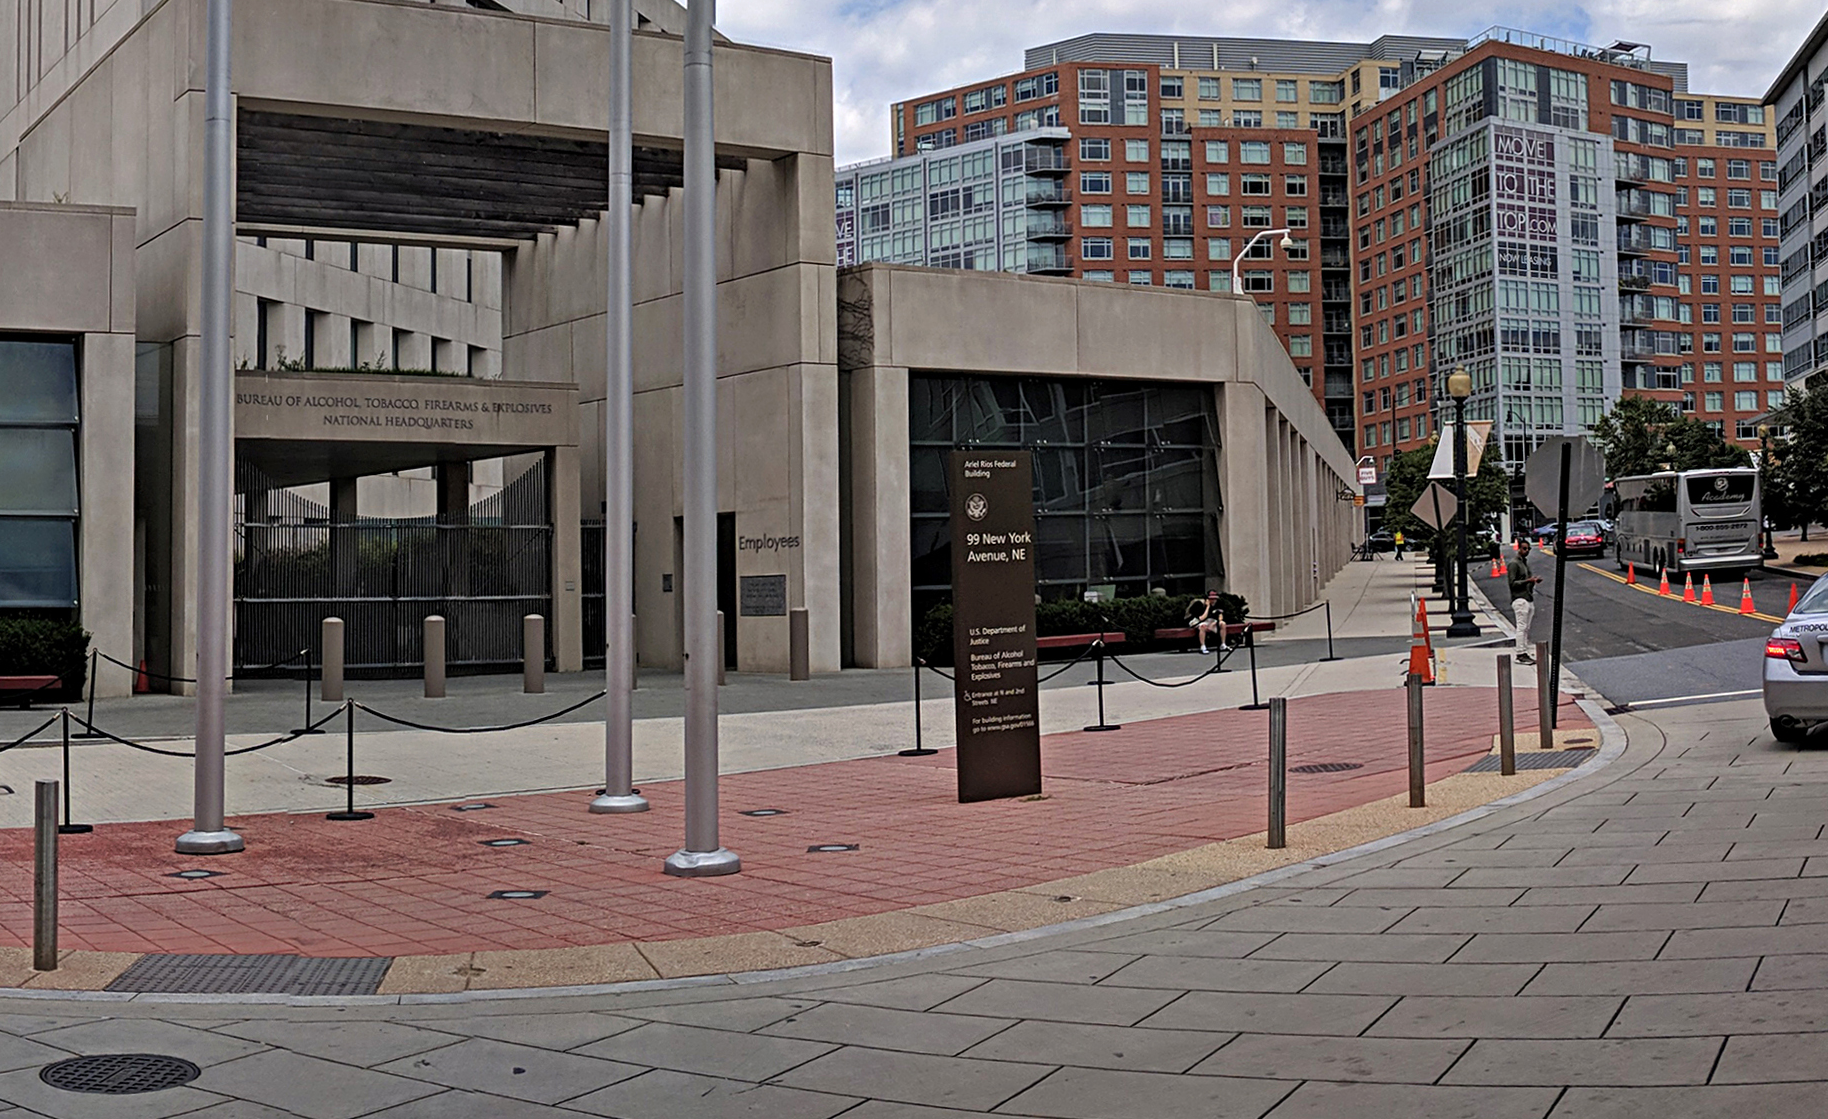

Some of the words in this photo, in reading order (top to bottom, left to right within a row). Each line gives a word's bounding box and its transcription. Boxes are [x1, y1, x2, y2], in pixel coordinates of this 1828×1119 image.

[1498, 135, 1544, 158] MOVE
[1497, 173, 1517, 193] TO
[1529, 177, 1555, 197] THE
[836, 222, 852, 238] VE
[837, 246, 853, 266] HE
[1500, 253, 1520, 262] NOW
[237, 394, 283, 407] BUREAU
[286, 396, 301, 407] OF
[304, 397, 361, 408] ALCOHOL,
[425, 400, 478, 412] FIREARMS
[482, 403, 490, 413] &
[493, 403, 552, 414] EXPLOSIVES
[324, 416, 382, 426] NATIONAL
[386, 417, 474, 430] HEADQUARTERS
[994, 460, 1017, 468] Federal
[965, 470, 990, 479] Building
[1702, 491, 1745, 502] Academy
[739, 534, 800, 553] Employees
[967, 533, 980, 545] 99
[983, 533, 1006, 544] New
[1008, 531, 1032, 544] York
[967, 551, 1009, 562] Avenue,
[1012, 549, 1026, 560] NE
[970, 628, 981, 636] U.S.
[983, 627, 1018, 636] Department
[1019, 624, 1026, 632] of
[970, 638, 990, 646] Justice
[971, 654, 992, 662] Bureau
[998, 661, 1022, 669] Firearms
[1023, 658, 1035, 667] and
[971, 673, 1002, 681] Explosives
